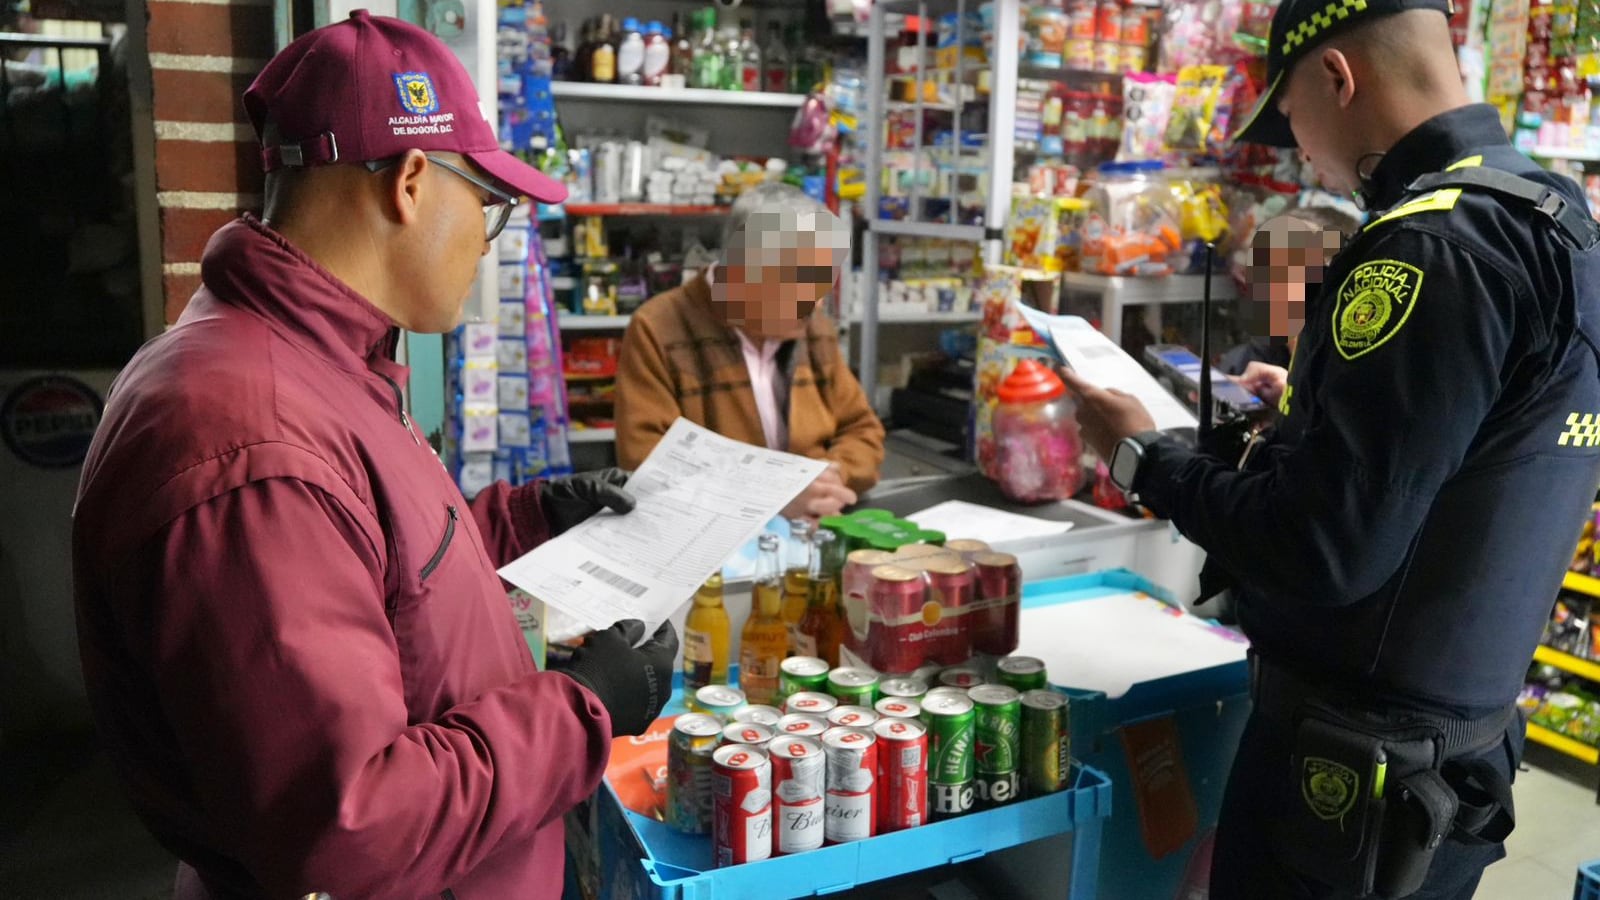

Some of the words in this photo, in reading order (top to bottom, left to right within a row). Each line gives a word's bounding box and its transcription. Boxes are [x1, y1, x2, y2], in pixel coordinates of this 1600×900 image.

[388, 115, 428, 125] ALCALDÍA
[429, 113, 454, 123] MAYOR
[393, 127, 407, 136] DE
[407, 123, 440, 135] BOGOTÁ
[1354, 264, 1412, 289] POLICÍA
[1343, 277, 1408, 304] NACIONAL
